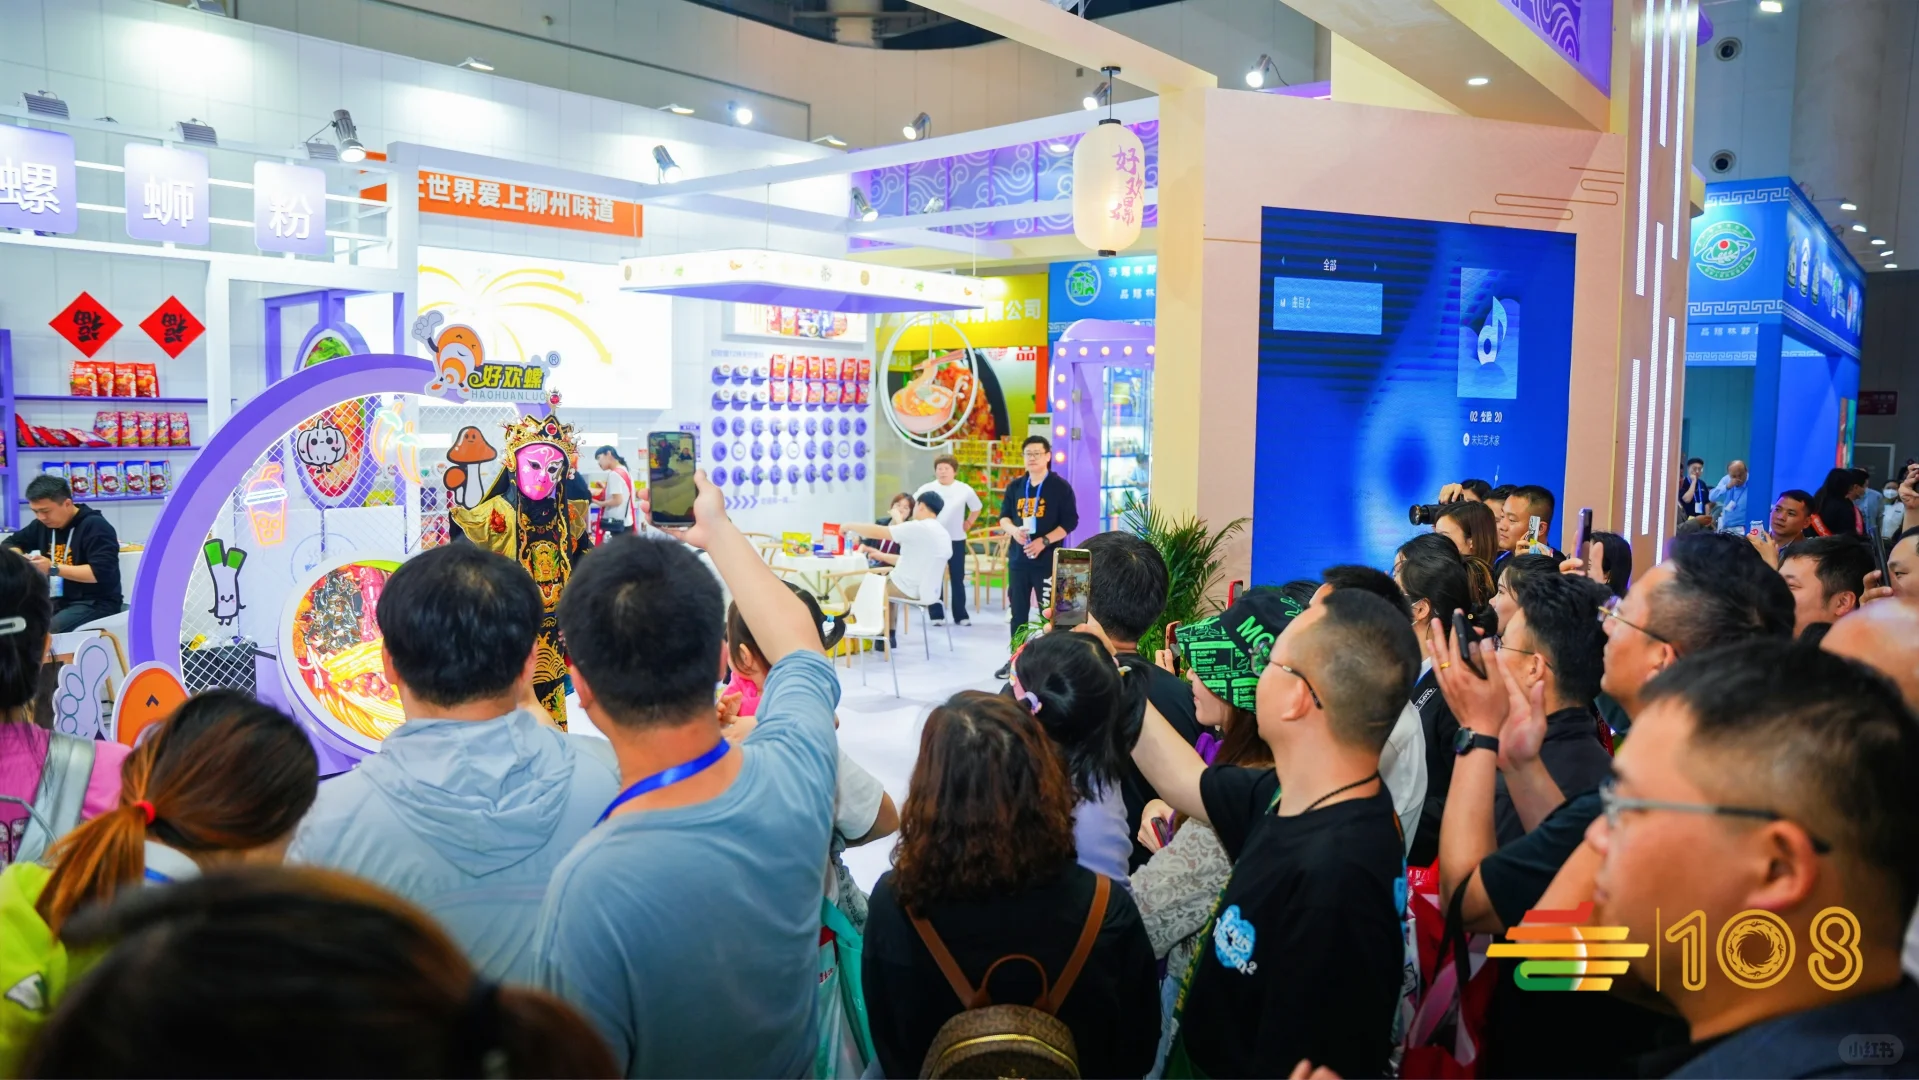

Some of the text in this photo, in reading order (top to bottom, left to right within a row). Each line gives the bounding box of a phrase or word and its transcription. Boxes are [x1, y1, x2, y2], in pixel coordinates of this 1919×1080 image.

[0, 157, 314, 240] 螺 蛳 粉
[1323, 258, 1337, 271] 全部
[73, 310, 104, 343] 福
[161, 312, 188, 344] 福
[468, 364, 544, 389] 好欢螺
[471, 390, 546, 401] HAOHUANLUO
